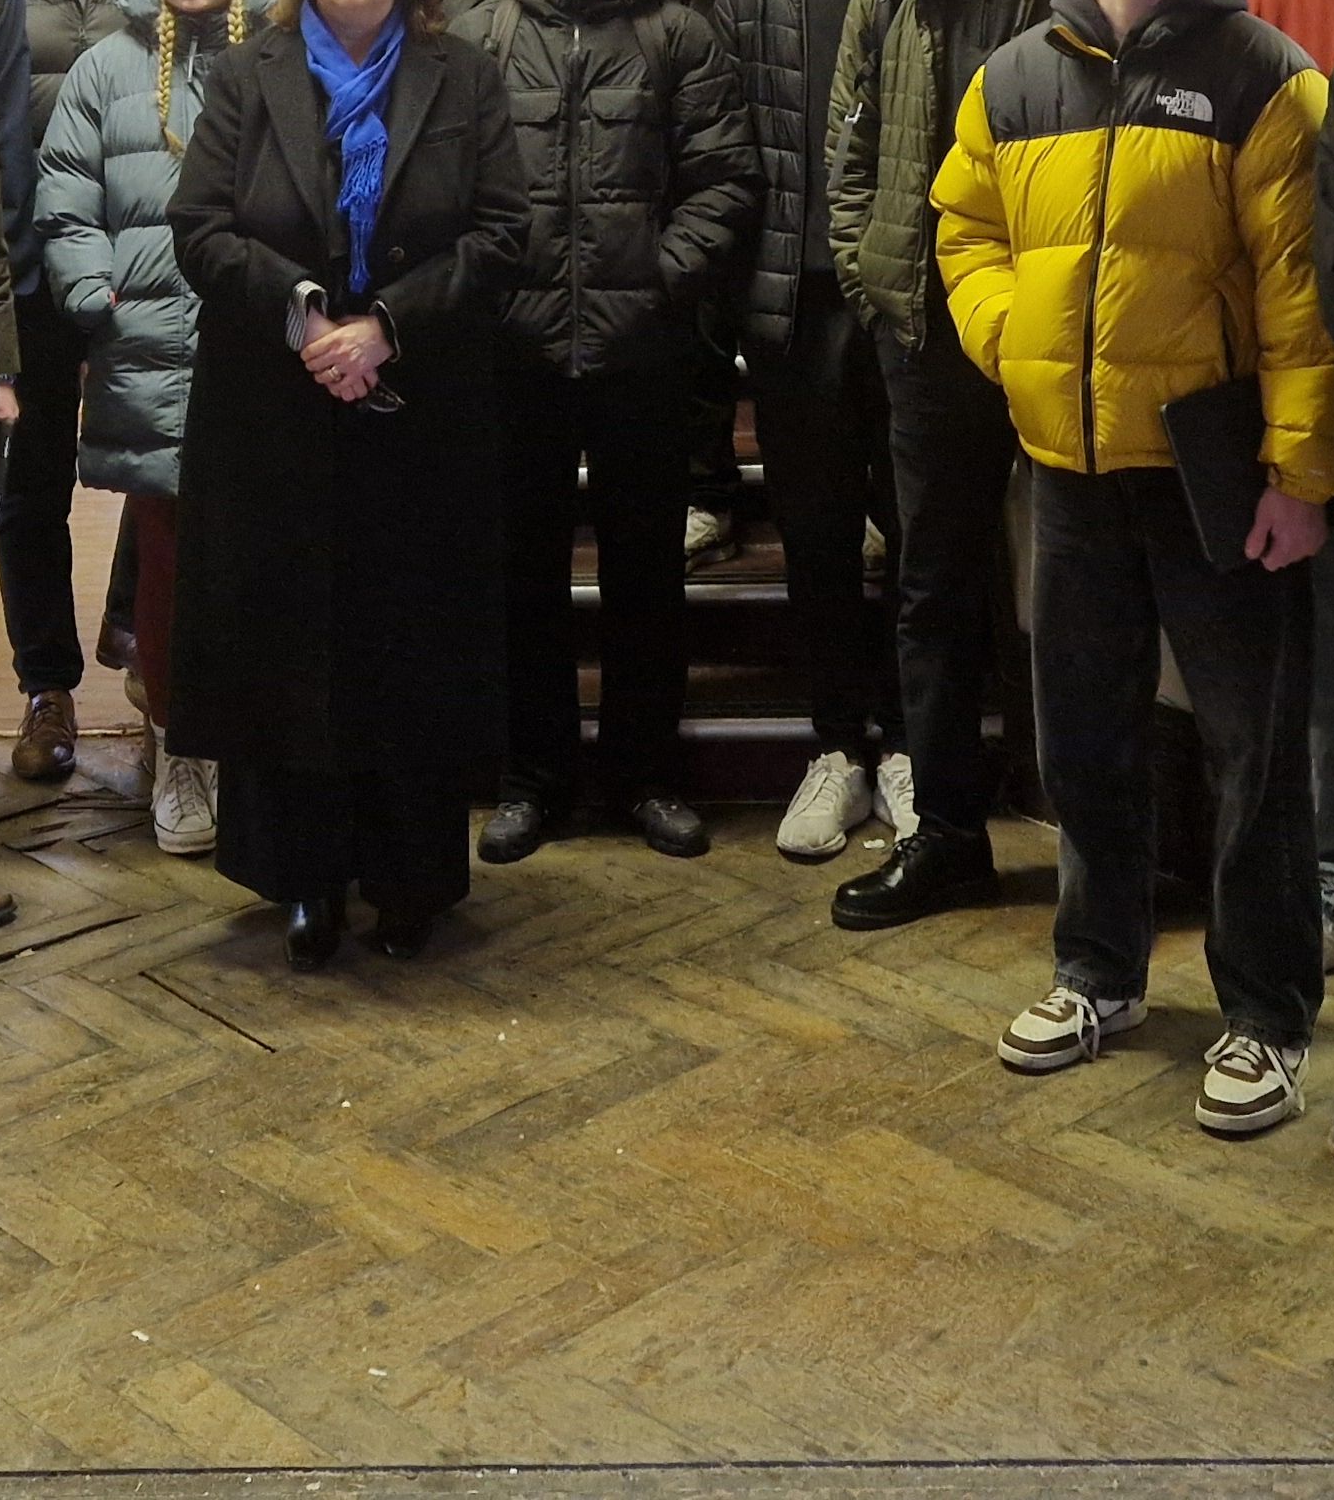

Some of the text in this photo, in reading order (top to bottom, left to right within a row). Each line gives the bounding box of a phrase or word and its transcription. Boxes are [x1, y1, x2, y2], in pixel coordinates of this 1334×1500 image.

[1175, 88, 1195, 100] THE
[1156, 94, 1195, 110] NORTH
[1166, 105, 1195, 118] FACE
